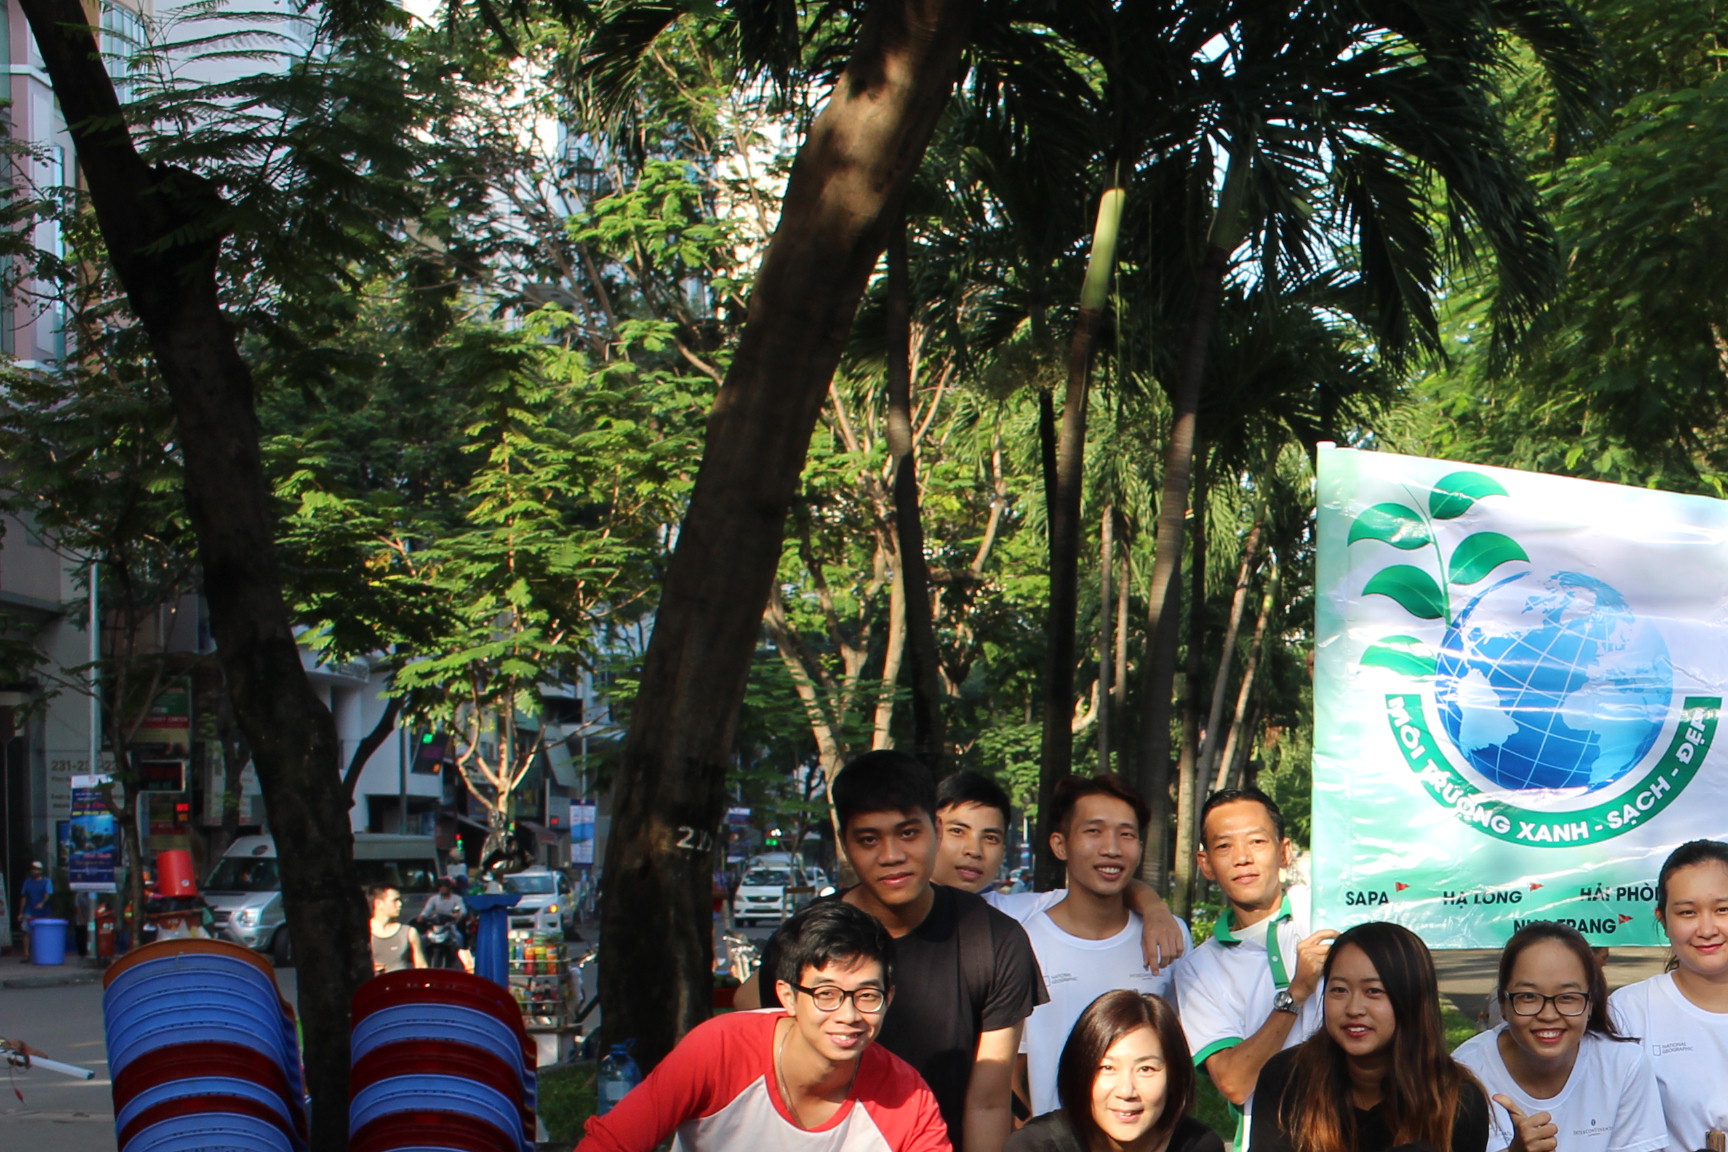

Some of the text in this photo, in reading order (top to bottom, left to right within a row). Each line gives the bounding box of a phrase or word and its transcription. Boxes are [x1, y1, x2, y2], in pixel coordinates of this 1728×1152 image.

[1388, 696, 1426, 760] MÔI
[1515, 820, 1590, 843] XANH
[1606, 774, 1671, 830] SẠCH
[1345, 891, 1390, 905] SAPA
[1443, 890, 1523, 909] HẠ LONG
